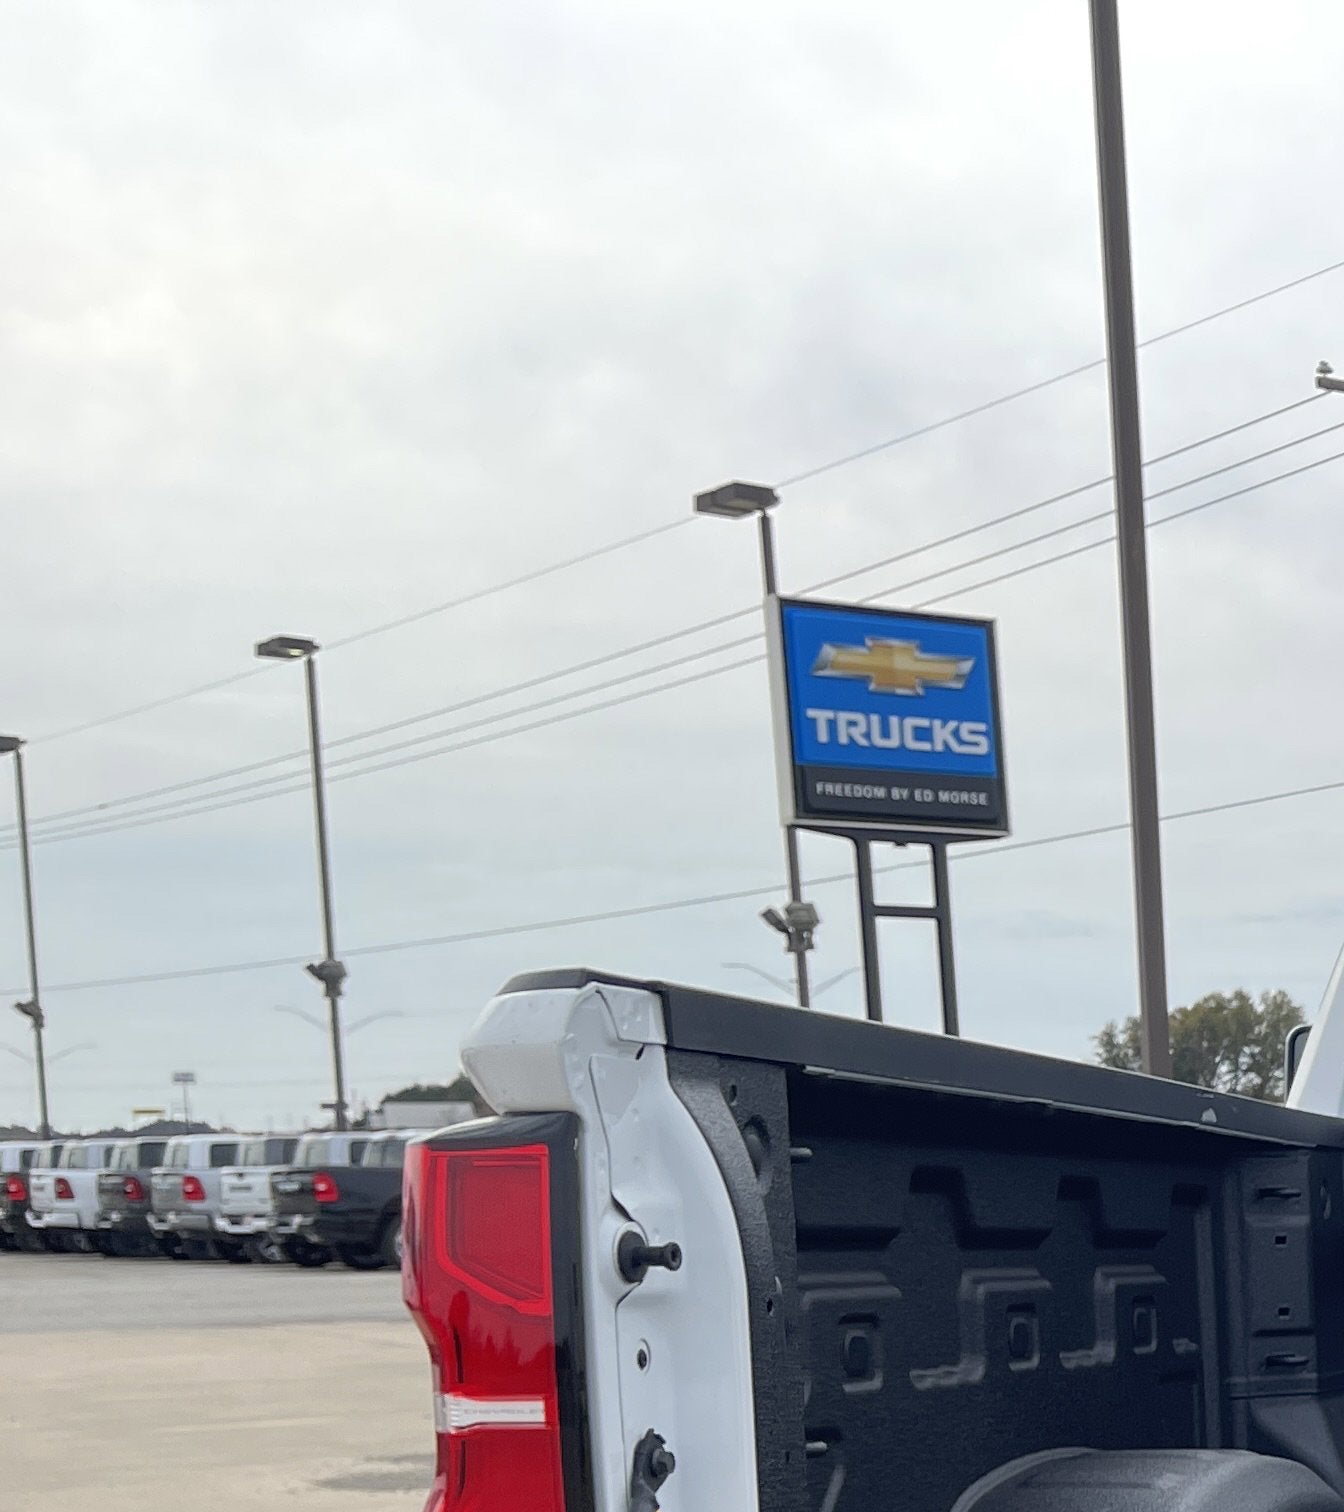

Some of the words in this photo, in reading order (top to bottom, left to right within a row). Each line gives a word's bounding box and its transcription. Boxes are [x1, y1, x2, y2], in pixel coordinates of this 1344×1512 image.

[806, 708, 989, 755] TRUCKS
[816, 782, 886, 799] FREEDOM
[890, 786, 911, 801] BY
[914, 788, 935, 803] ED
[938, 790, 989, 806] MORSE
